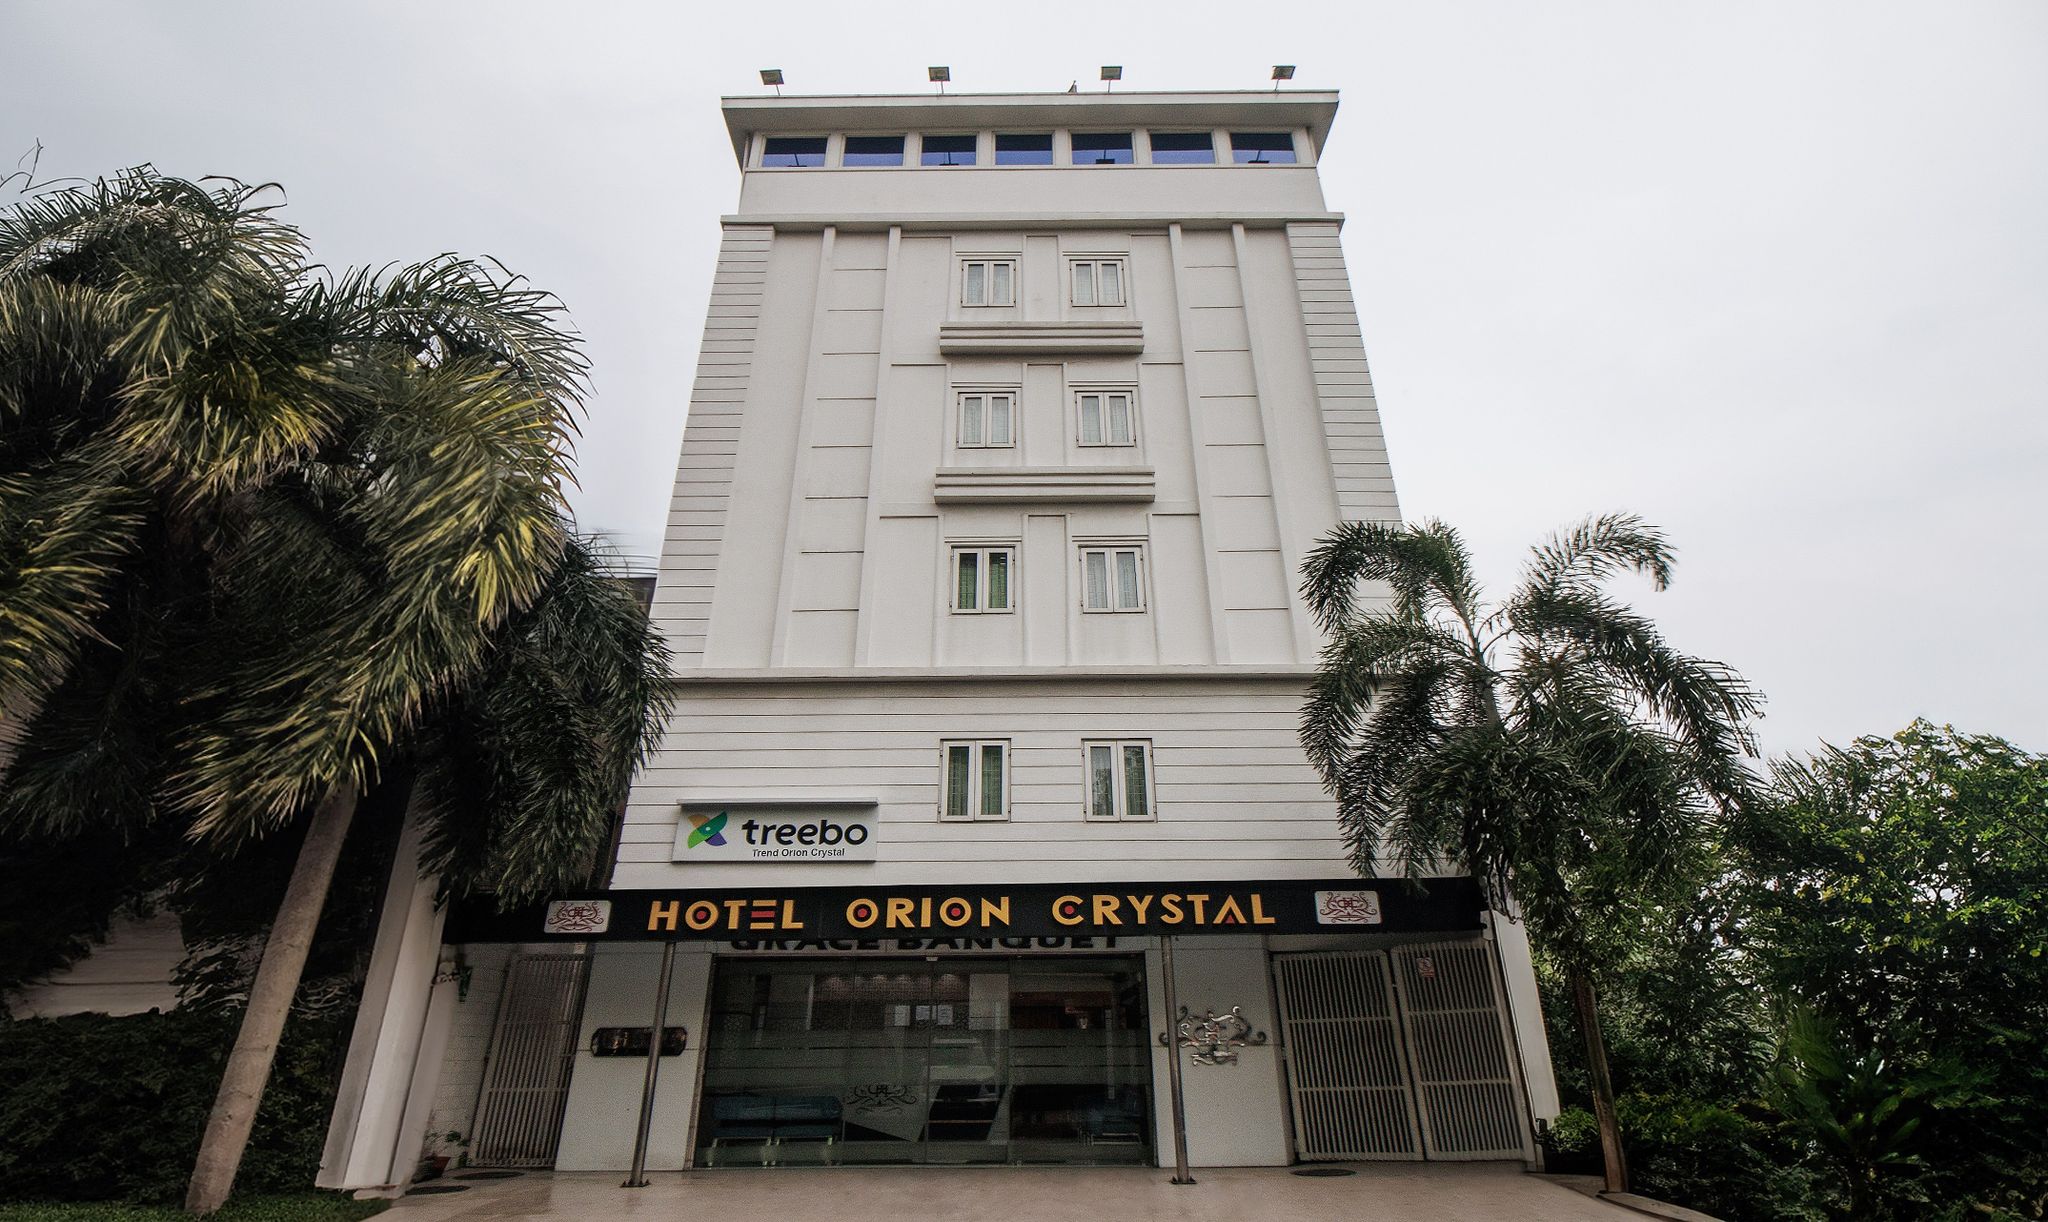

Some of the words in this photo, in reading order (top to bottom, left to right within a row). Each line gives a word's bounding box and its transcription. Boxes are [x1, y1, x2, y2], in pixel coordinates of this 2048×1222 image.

[742, 819, 868, 845] treebo
[752, 849, 778, 857] Trend
[781, 848, 808, 857] Orion
[811, 848, 845, 858] Crystal
[647, 899, 804, 930] HOTEL
[846, 896, 1010, 928] ORION
[1052, 894, 1276, 925] CRYSTAL
